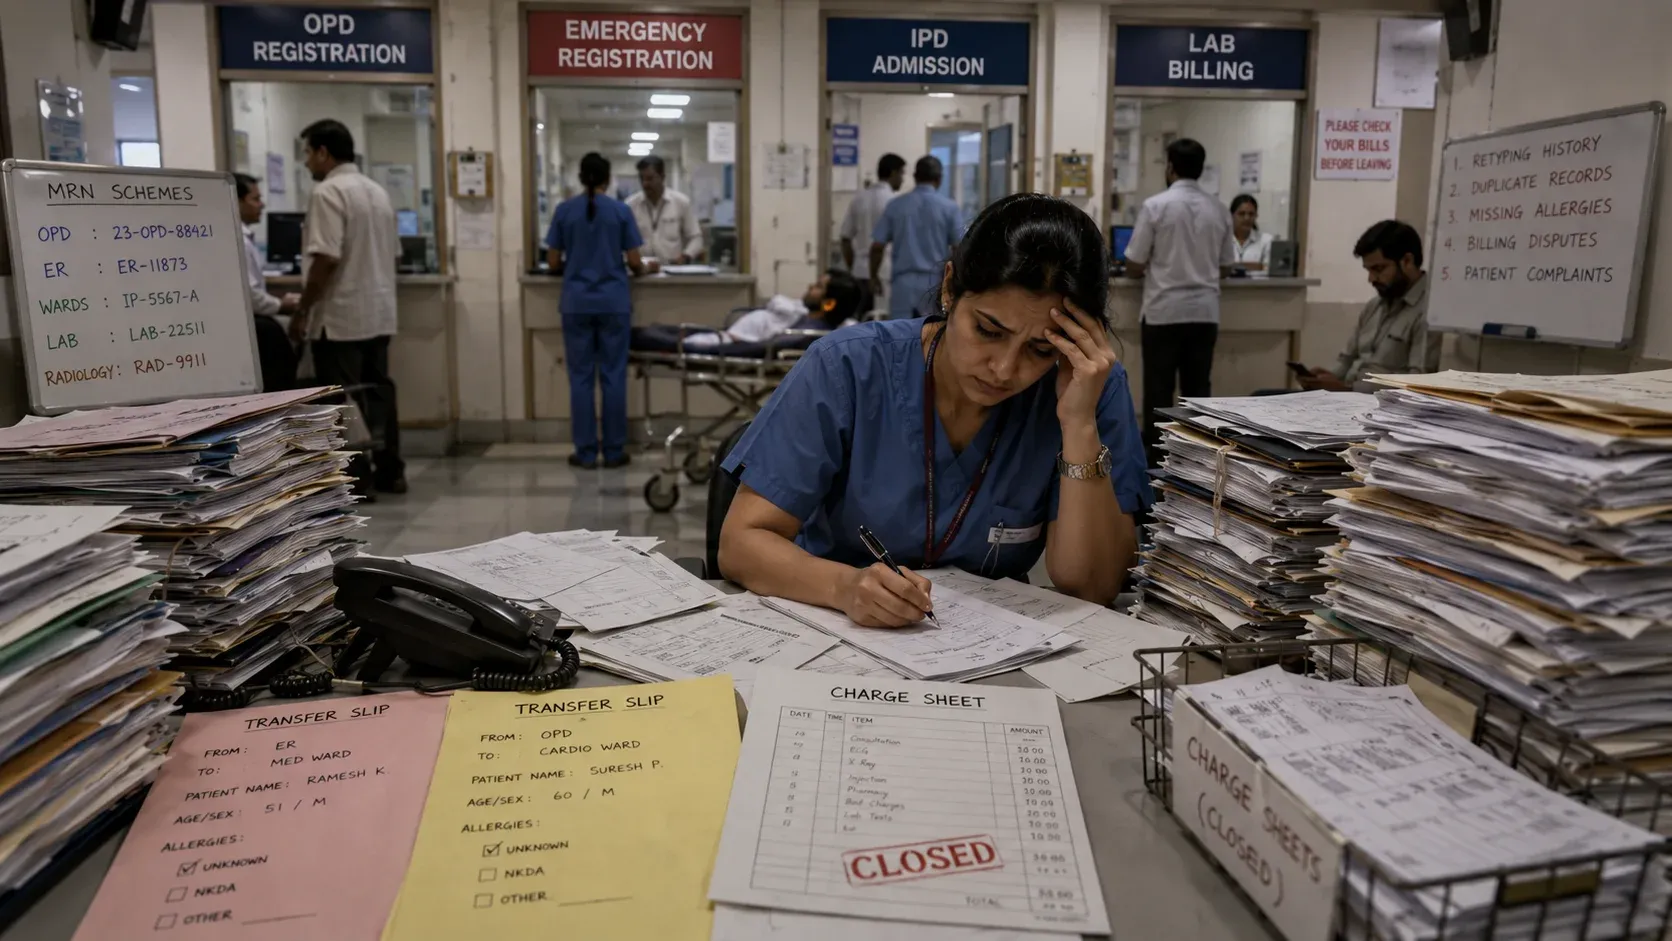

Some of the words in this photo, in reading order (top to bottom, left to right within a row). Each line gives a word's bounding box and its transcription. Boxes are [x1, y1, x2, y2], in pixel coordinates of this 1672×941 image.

[304, 14, 355, 35] OPD
[565, 20, 707, 42] EMERGENCY
[911, 28, 949, 49] IPD
[1189, 33, 1235, 53] LAB
[253, 42, 406, 64] REGISTRATION
[558, 48, 713, 70] REGISTRATION
[872, 56, 984, 76] ADMISSION
[1168, 61, 1255, 82] BILLING
[1325, 120, 1359, 133] PLEASE
[1362, 120, 1392, 134] CHECK
[1325, 138, 1354, 152] YOUR
[1358, 139, 1390, 152] BILLS
[1472, 146, 1531, 168] RETYPING
[1543, 135, 1602, 157] HISTORY
[1321, 157, 1353, 171] BEFORE
[1355, 158, 1393, 171] LEAVING
[47, 183, 95, 201] MRN
[111, 185, 194, 201] SCHEMES
[1450, 183, 1461, 198] 2.
[1471, 175, 1537, 195] DUPLICATE
[1549, 167, 1613, 188] RECORDS
[1448, 209, 1458, 224] 3.
[1469, 203, 1523, 221] MISSING
[1535, 198, 1613, 217] ALLERGIES
[37, 226, 71, 242] OPD
[112, 225, 213, 241] 23-OPD-88421
[1444, 238, 1455, 252] 4.
[1467, 232, 1517, 251] BILLING
[1529, 231, 1597, 249] DISPUTES
[44, 262, 68, 279] ER
[117, 257, 188, 275] ER-11873
[1441, 266, 1452, 281] 5.
[1465, 265, 1517, 281] PATIENT
[1527, 266, 1614, 282] COMPLAINTS
[38, 297, 89, 315] WARDS
[122, 289, 200, 308] IP-5567-A
[46, 334, 79, 350] LAB
[129, 322, 205, 342] LAB-22511
[134, 354, 207, 374] RAD-9911
[514, 699, 612, 715] TRANSFER
[626, 694, 665, 708] SLIP
[830, 686, 910, 704] CHARGE
[923, 693, 986, 708] SHEET
[245, 710, 337, 730] TRANSFER
[351, 704, 391, 719] SLIP
[790, 710, 811, 719] DATE
[1009, 727, 1044, 735] AMOUNT
[541, 729, 573, 740] OPD
[276, 740, 296, 751] ER
[477, 752, 501, 760] TO:
[540, 744, 592, 756] CARDIO
[600, 740, 641, 751] WARD
[198, 766, 221, 777] TO:
[270, 755, 303, 768] MED
[312, 750, 352, 762] WARD
[471, 773, 523, 784] PATIENT
[590, 762, 643, 776] SURESH
[652, 760, 664, 770] P.
[185, 787, 239, 802] PATIENT
[307, 769, 366, 785] RAMESH
[553, 790, 573, 801] 60
[602, 787, 615, 797] M
[312, 797, 327, 807] M
[1187, 736, 1253, 812] CHARGE
[1262, 806, 1323, 884] SHEETS
[506, 840, 569, 855] UNKNOWN
[202, 855, 268, 872] UNKNOWN
[849, 841, 995, 880] CLOSED
[504, 866, 545, 879] NKDA
[194, 883, 236, 897] NKDA
[500, 891, 548, 905] OTHER
[182, 909, 233, 926] OTHER
